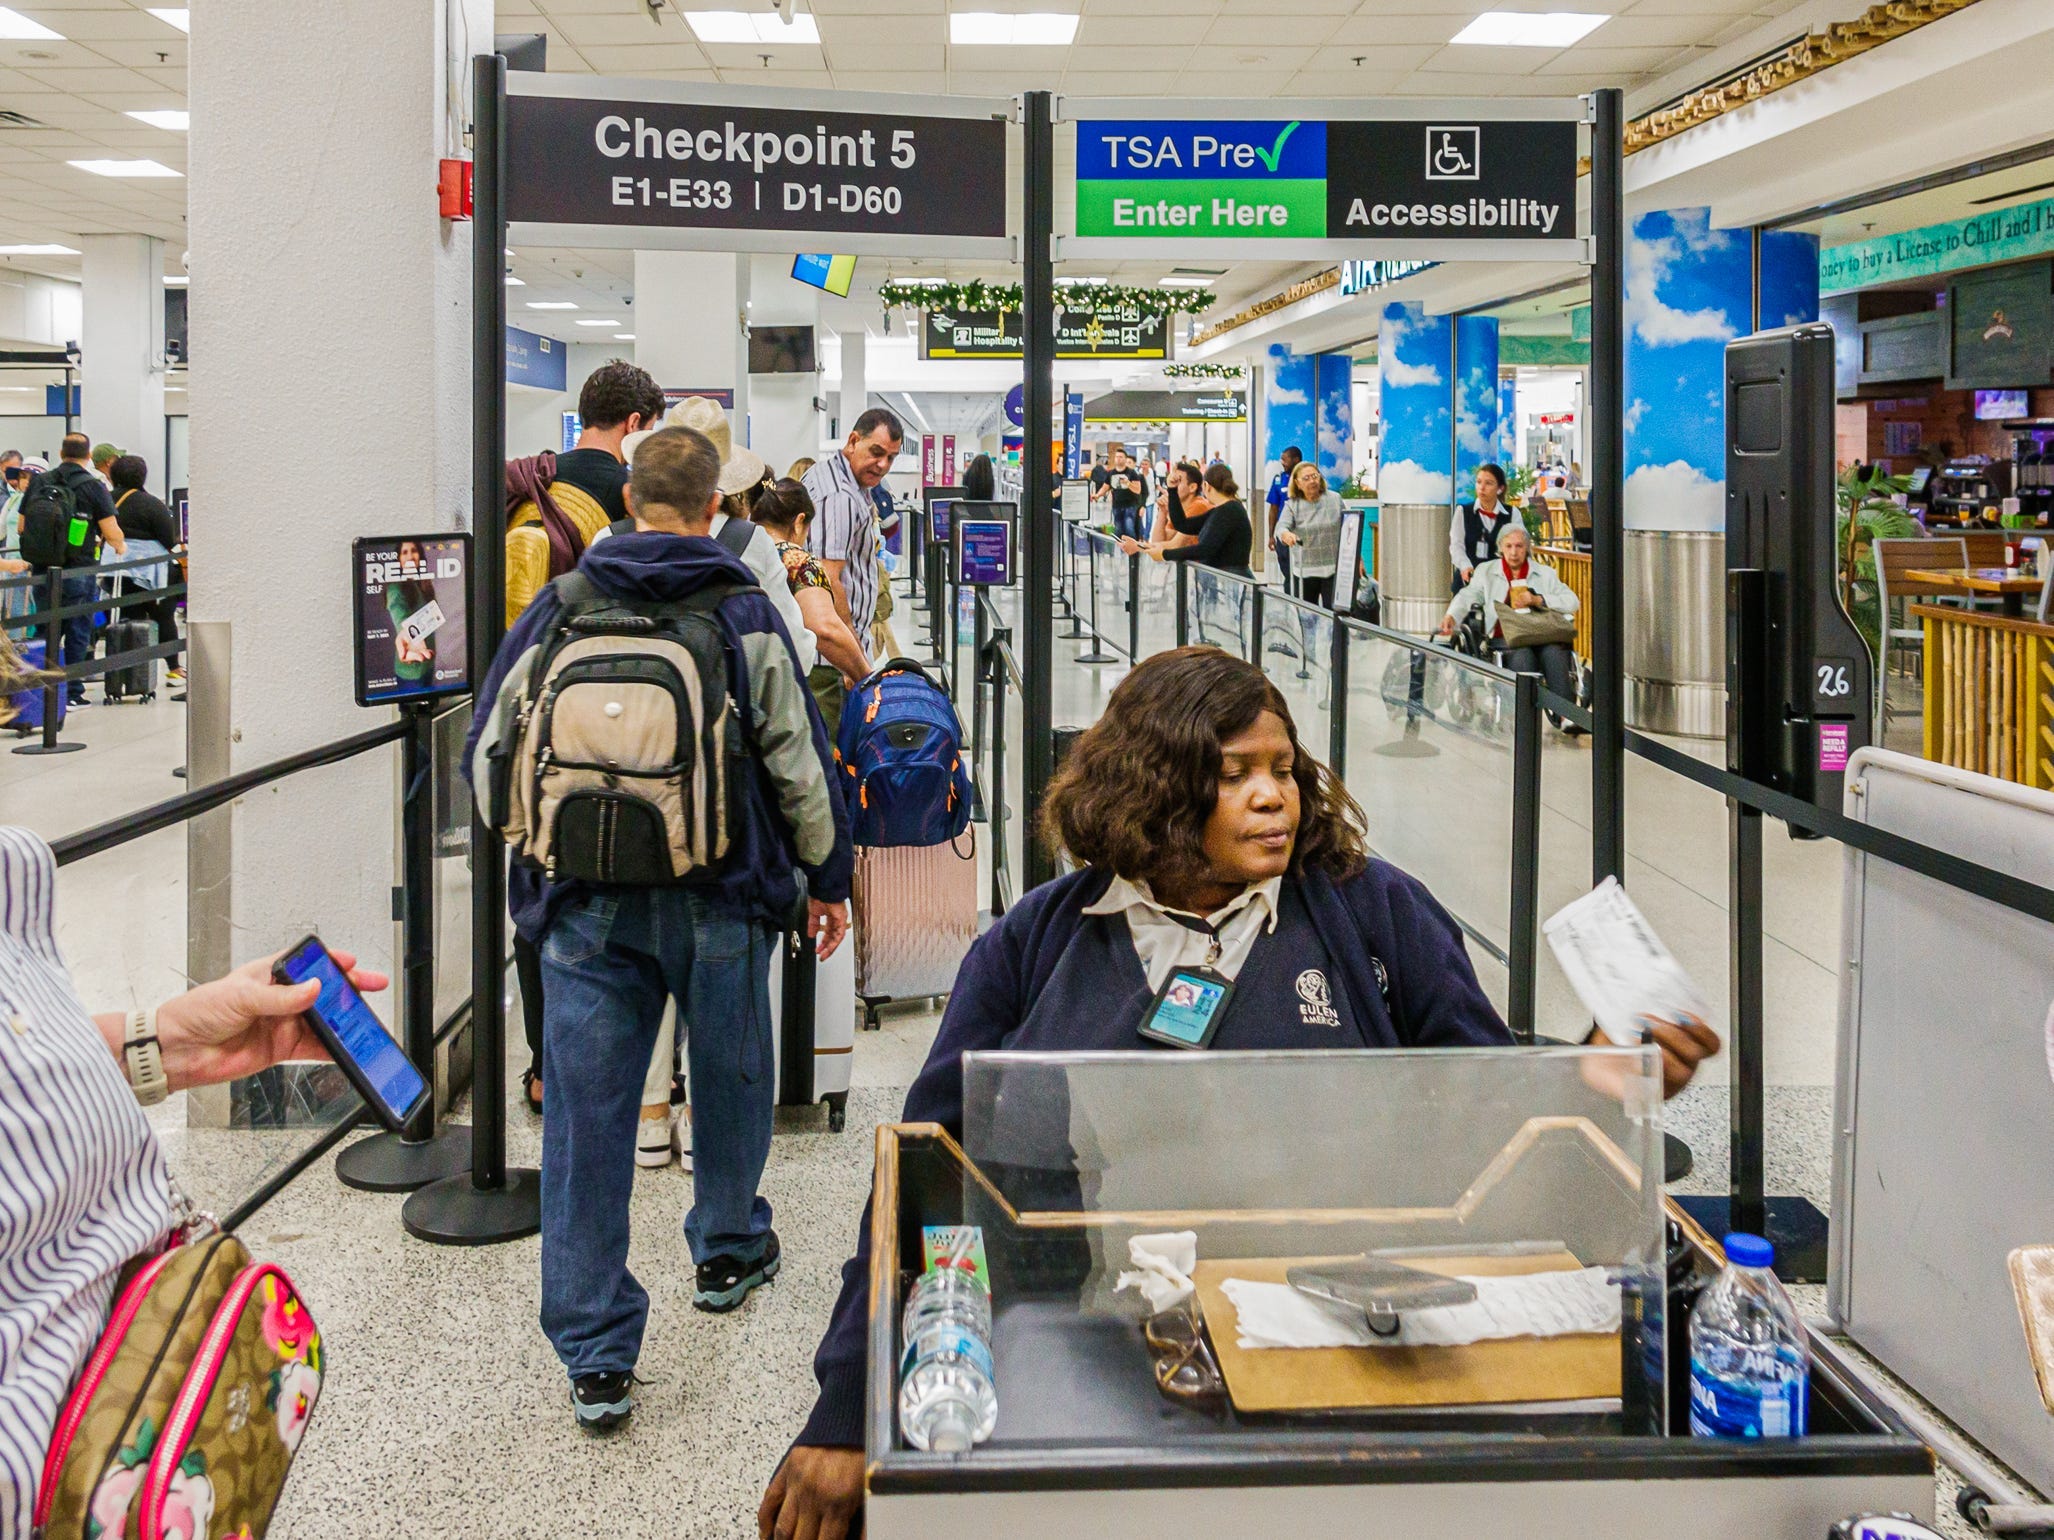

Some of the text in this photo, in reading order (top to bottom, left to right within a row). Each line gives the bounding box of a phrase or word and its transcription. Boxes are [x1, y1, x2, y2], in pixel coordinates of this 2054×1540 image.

[595, 115, 917, 173] Checkpoint 5
[1101, 136, 1256, 169] TSA Pre
[611, 176, 733, 210] E1-E33
[782, 182, 903, 215] D1-D60
[1112, 198, 1289, 227] Enter Here
[1345, 197, 1560, 234] Accessibility
[1821, 262, 1846, 279] oney
[1850, 256, 1861, 272] to
[1863, 249, 1884, 269] buy
[1886, 250, 1893, 264] a
[1896, 239, 1942, 263] License
[1946, 234, 1960, 251] to
[1963, 217, 2002, 248] Chill
[2005, 210, 2030, 239] and
[973, 327, 1003, 336] Militar
[1068, 424, 1077, 456] TSA
[365, 551, 398, 562] BE YOUR
[366, 557, 462, 584] REAL ID
[366, 584, 383, 595] SELF
[1817, 664, 1850, 697] 26
[1299, 1003, 1339, 1019] EULEN
[1302, 1014, 1342, 1028] AMERICA
